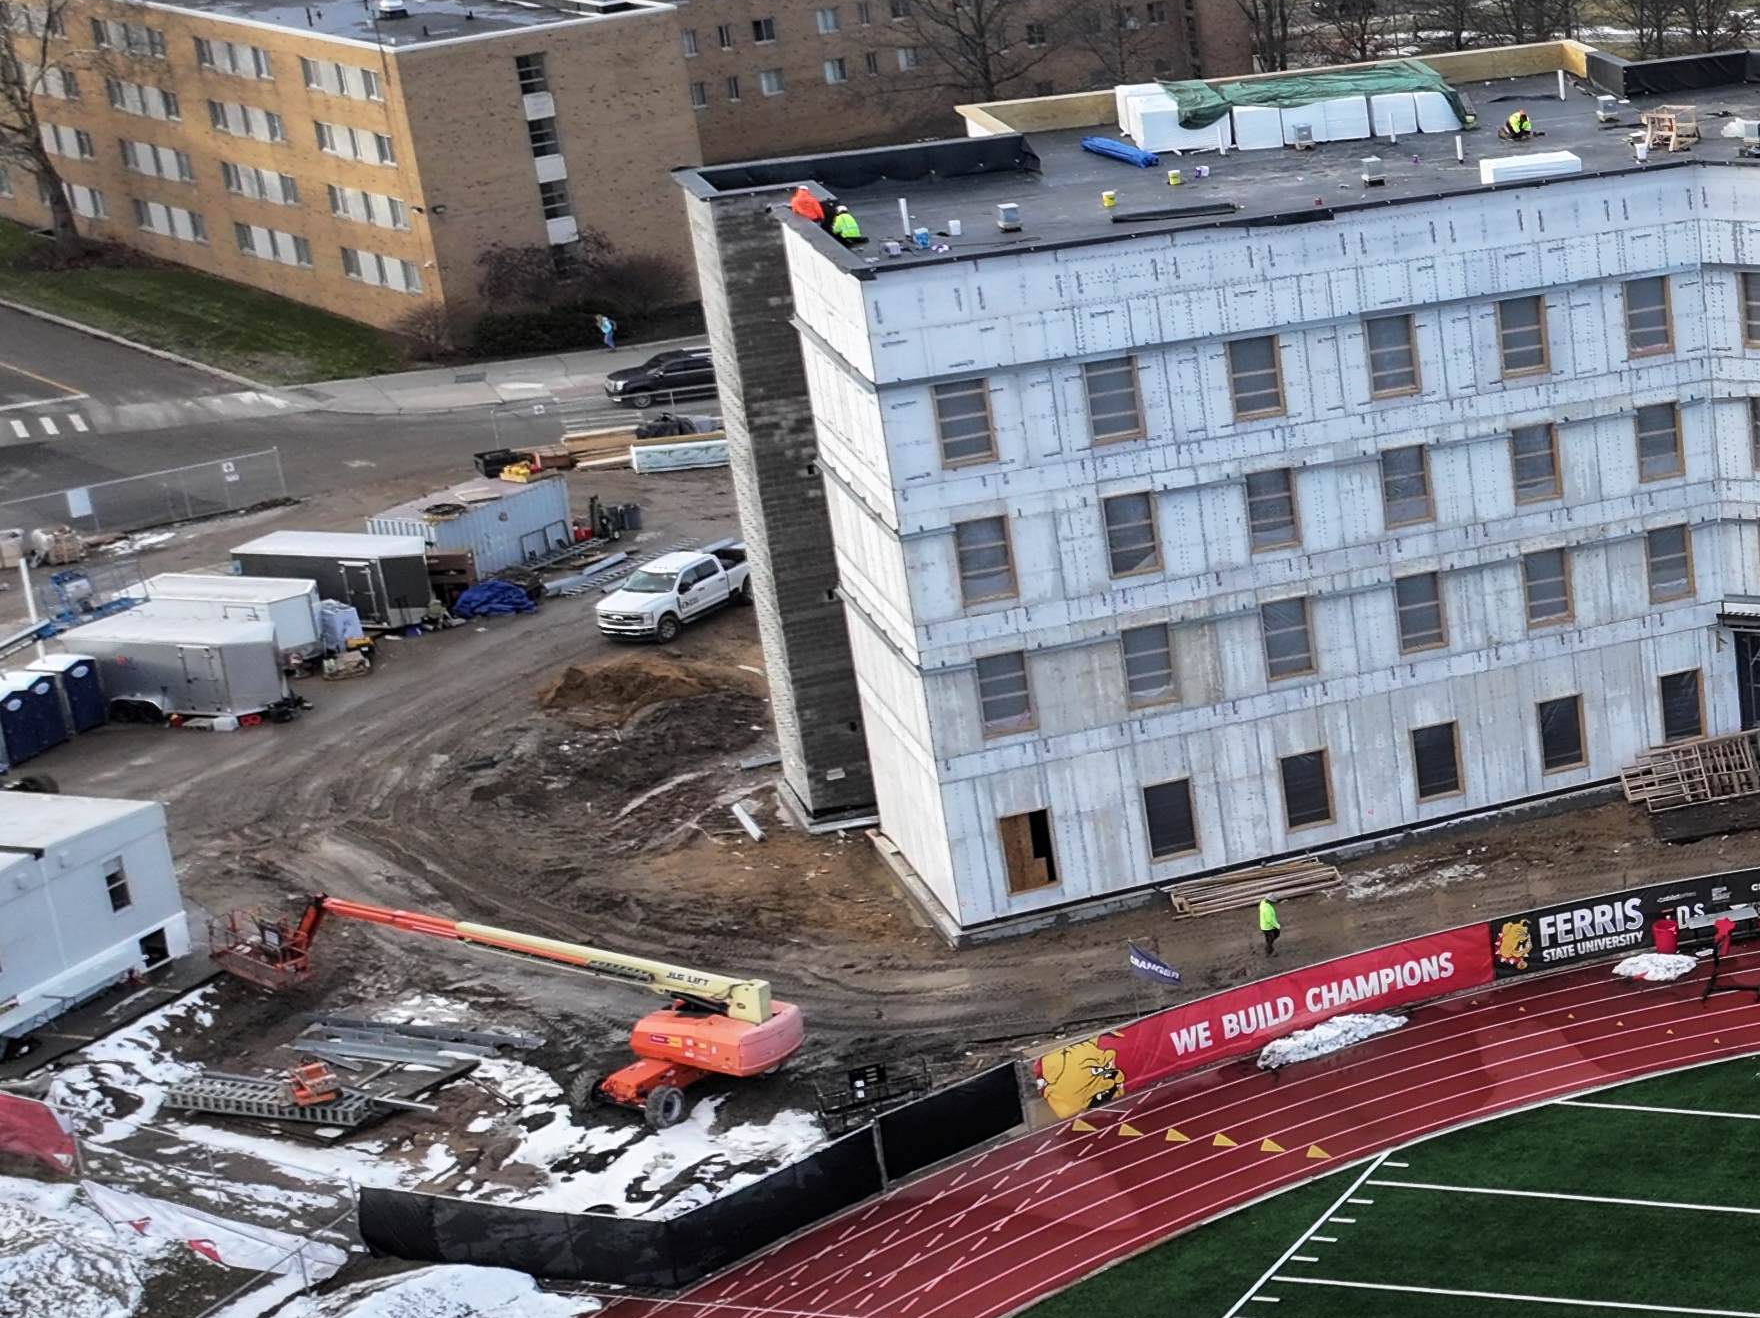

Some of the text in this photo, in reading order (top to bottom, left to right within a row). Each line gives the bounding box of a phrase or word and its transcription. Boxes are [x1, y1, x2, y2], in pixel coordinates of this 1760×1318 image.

[1538, 897, 1644, 948] FERRIS
[1541, 930, 1644, 963] STATE UNIVERSITY
[1170, 952, 1455, 1057] WE BUILD CHAMPIONS
